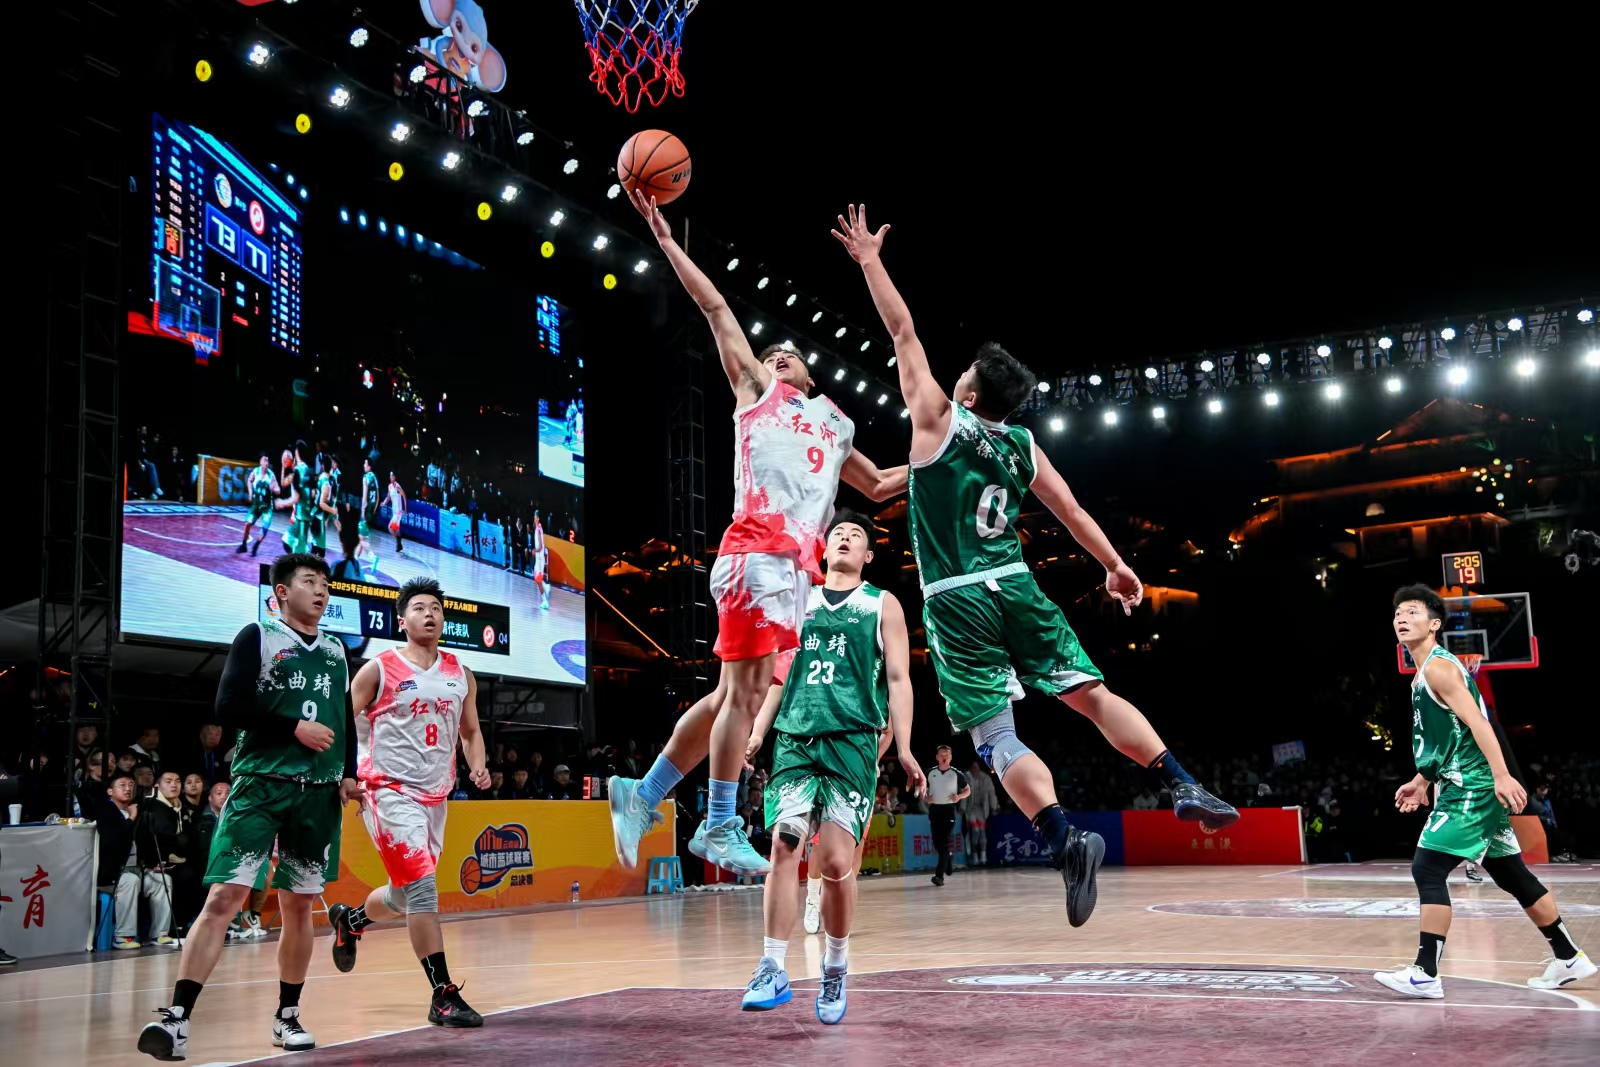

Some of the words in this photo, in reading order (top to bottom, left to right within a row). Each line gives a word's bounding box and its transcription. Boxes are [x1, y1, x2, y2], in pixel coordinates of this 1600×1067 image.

[211, 215, 236, 254] 73
[245, 240, 267, 275] 77
[792, 413, 837, 448] 红河
[807, 446, 825, 474] 9
[218, 464, 250, 502] GS
[976, 484, 1008, 539] 0
[1453, 555, 1480, 569] 2:05
[1459, 567, 1476, 584] 19
[322, 603, 344, 620] 表队
[368, 610, 384, 631] 73
[498, 632, 508, 645] Q4
[804, 632, 848, 657] 曲靖
[288, 669, 332, 699] 曲靖
[806, 659, 835, 685] 23
[301, 699, 318, 723] 9
[409, 697, 453, 719] 红河
[425, 723, 438, 747] 8
[480, 850, 531, 868] 城市篮球联赛
